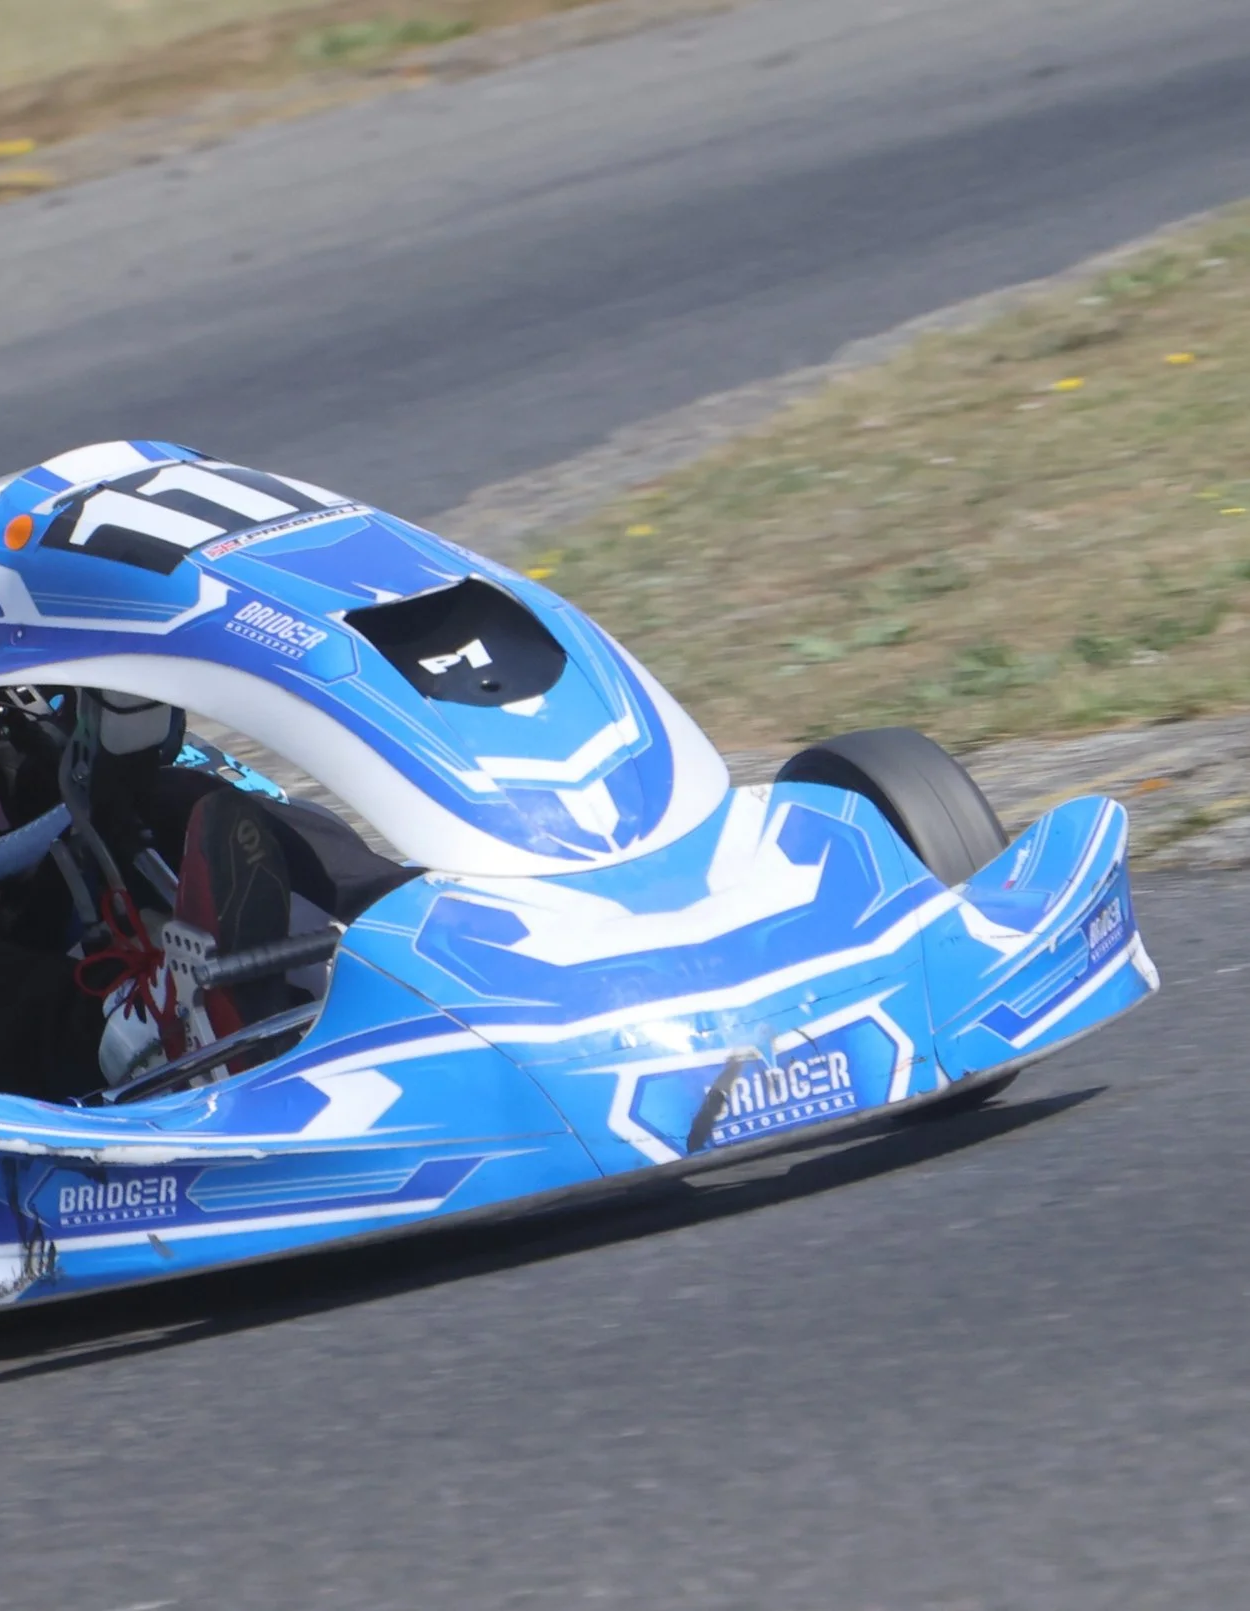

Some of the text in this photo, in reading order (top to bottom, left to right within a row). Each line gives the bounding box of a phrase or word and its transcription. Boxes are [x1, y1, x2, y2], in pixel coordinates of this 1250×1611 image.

[233, 600, 329, 650] BRIDGER
[712, 1094, 856, 1141] MOTORSPORT
[59, 1176, 178, 1214] BRIDGER
